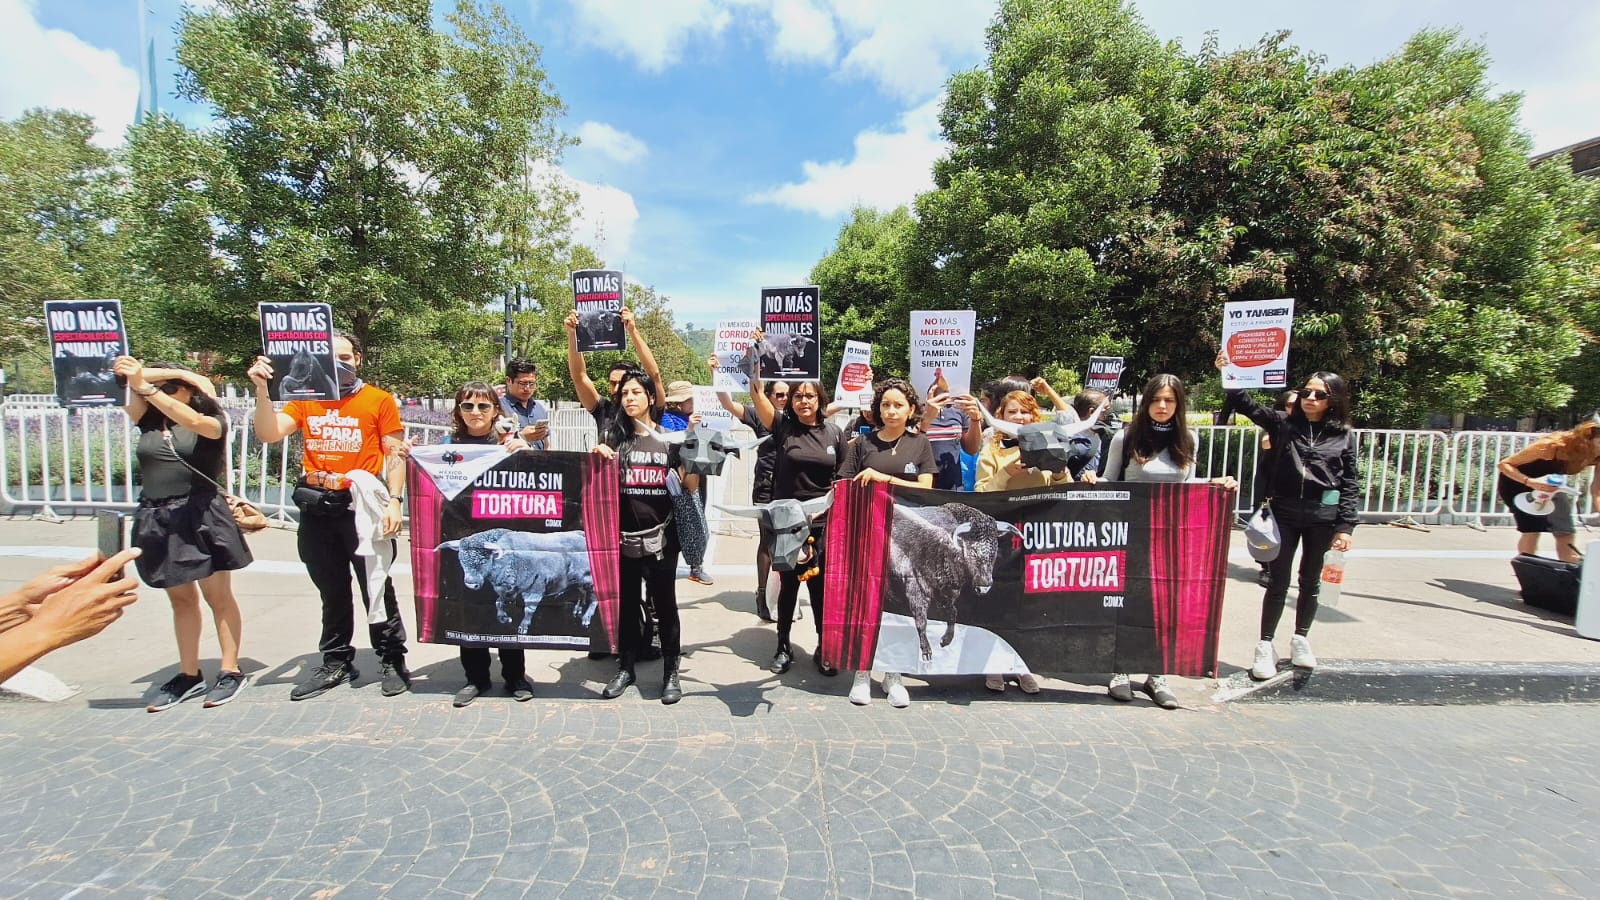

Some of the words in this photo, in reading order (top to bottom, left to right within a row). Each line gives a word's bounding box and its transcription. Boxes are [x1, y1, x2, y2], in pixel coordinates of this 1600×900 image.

[576, 277, 590, 293] NO
[593, 274, 619, 292] MÁS
[576, 300, 619, 312] ANIMALES
[765, 296, 782, 313] NO
[785, 292, 812, 313] MÁS
[50, 311, 76, 331] NO
[77, 306, 118, 331] MÁS
[265, 312, 287, 331] NO
[291, 307, 327, 331] MÁS
[765, 322, 812, 335] ANIMALES
[920, 328, 961, 336] MUERTES
[55, 342, 120, 357] ANIMALES
[268, 341, 329, 355] ANIMALES
[730, 342, 750, 351] TOR
[730, 354, 743, 363] SO
[1091, 362, 1103, 373] NO
[1105, 360, 1120, 373] MÁS
[1089, 379, 1117, 387] ANIMALES
[322, 427, 362, 442] PARA
[474, 471, 536, 489] CULTURA
[539, 472, 562, 490] SIN
[652, 487, 667, 495] MÉXICO
[478, 493, 557, 515] TORTURA
[545, 519, 562, 527] CDMX
[1101, 522, 1129, 546] SIN
[1030, 555, 1119, 589] TORTURA
[1103, 595, 1125, 607] CDMX
